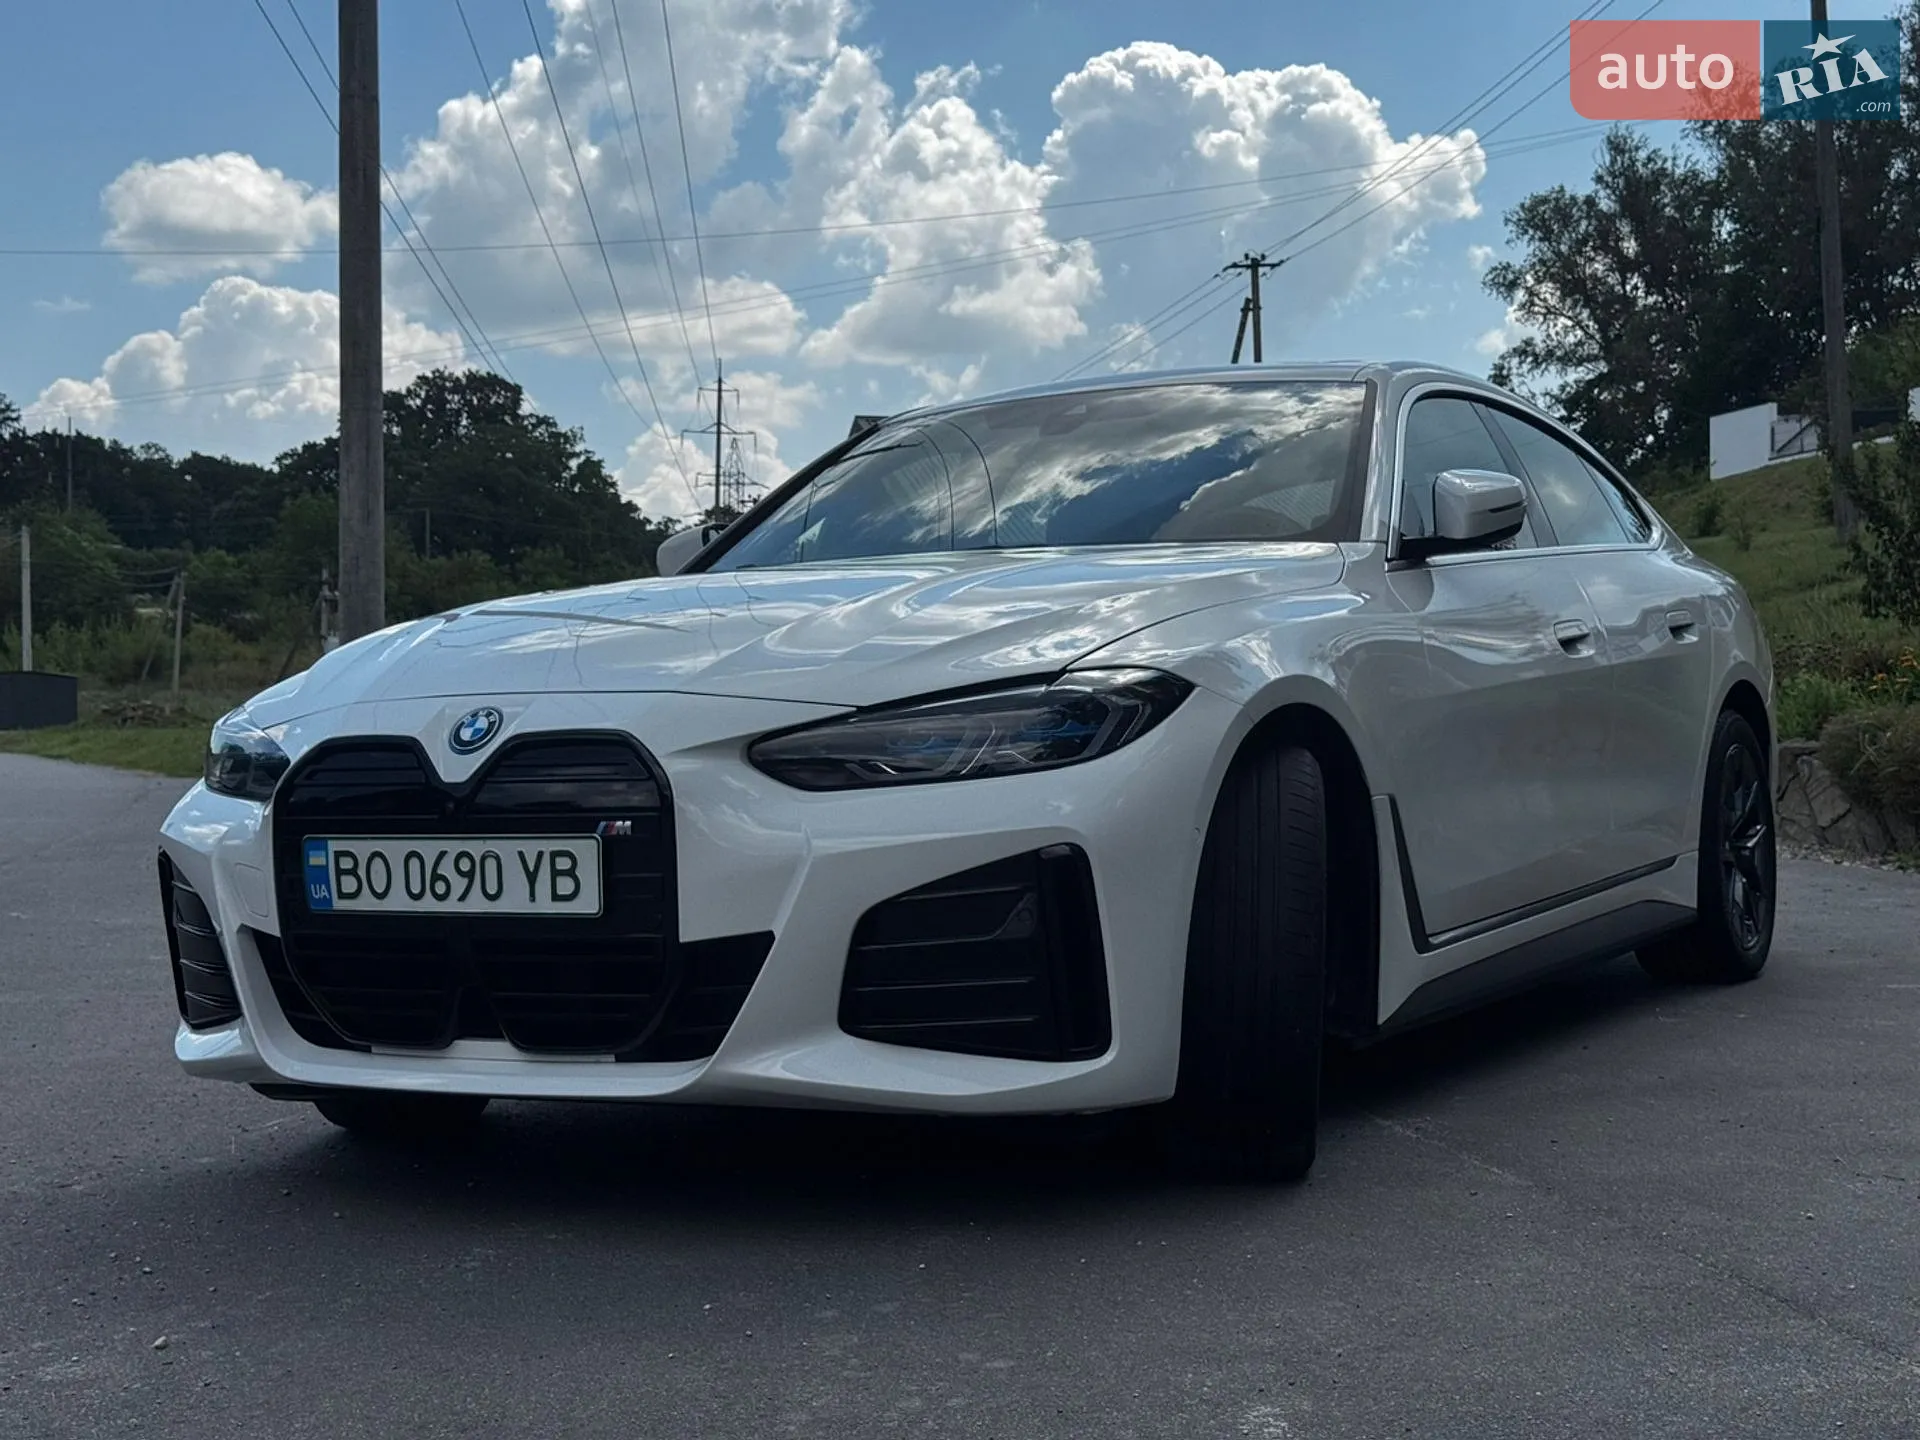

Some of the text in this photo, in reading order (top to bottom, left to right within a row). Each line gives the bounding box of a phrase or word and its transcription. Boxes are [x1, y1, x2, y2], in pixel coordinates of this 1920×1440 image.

[311, 884, 330, 899] UA
[333, 849, 581, 903] BO 0690 YB
